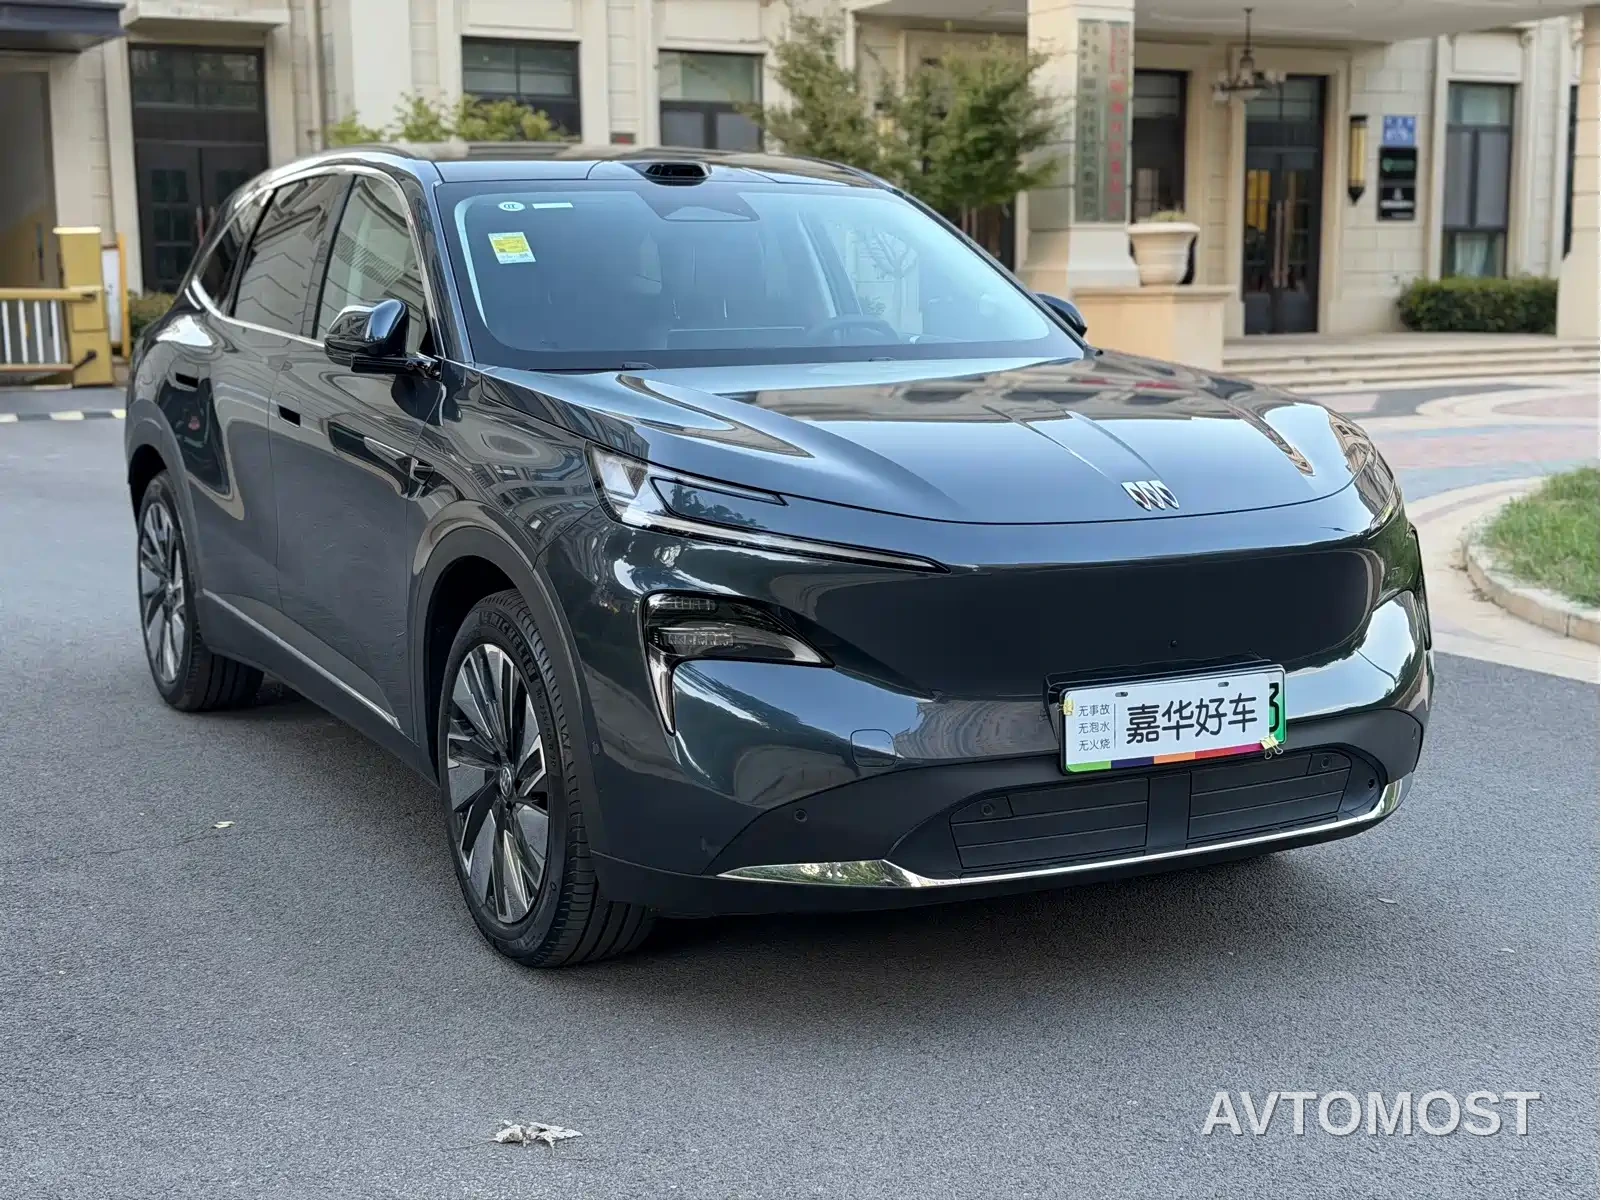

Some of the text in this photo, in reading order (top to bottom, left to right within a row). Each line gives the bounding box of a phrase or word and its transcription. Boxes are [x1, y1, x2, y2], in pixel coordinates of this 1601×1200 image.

[1077, 703, 1111, 718] 无事故
[1125, 692, 1258, 745] 嘉华好车
[1077, 720, 1111, 735] 无泡水
[1078, 738, 1111, 752] 无火烧
